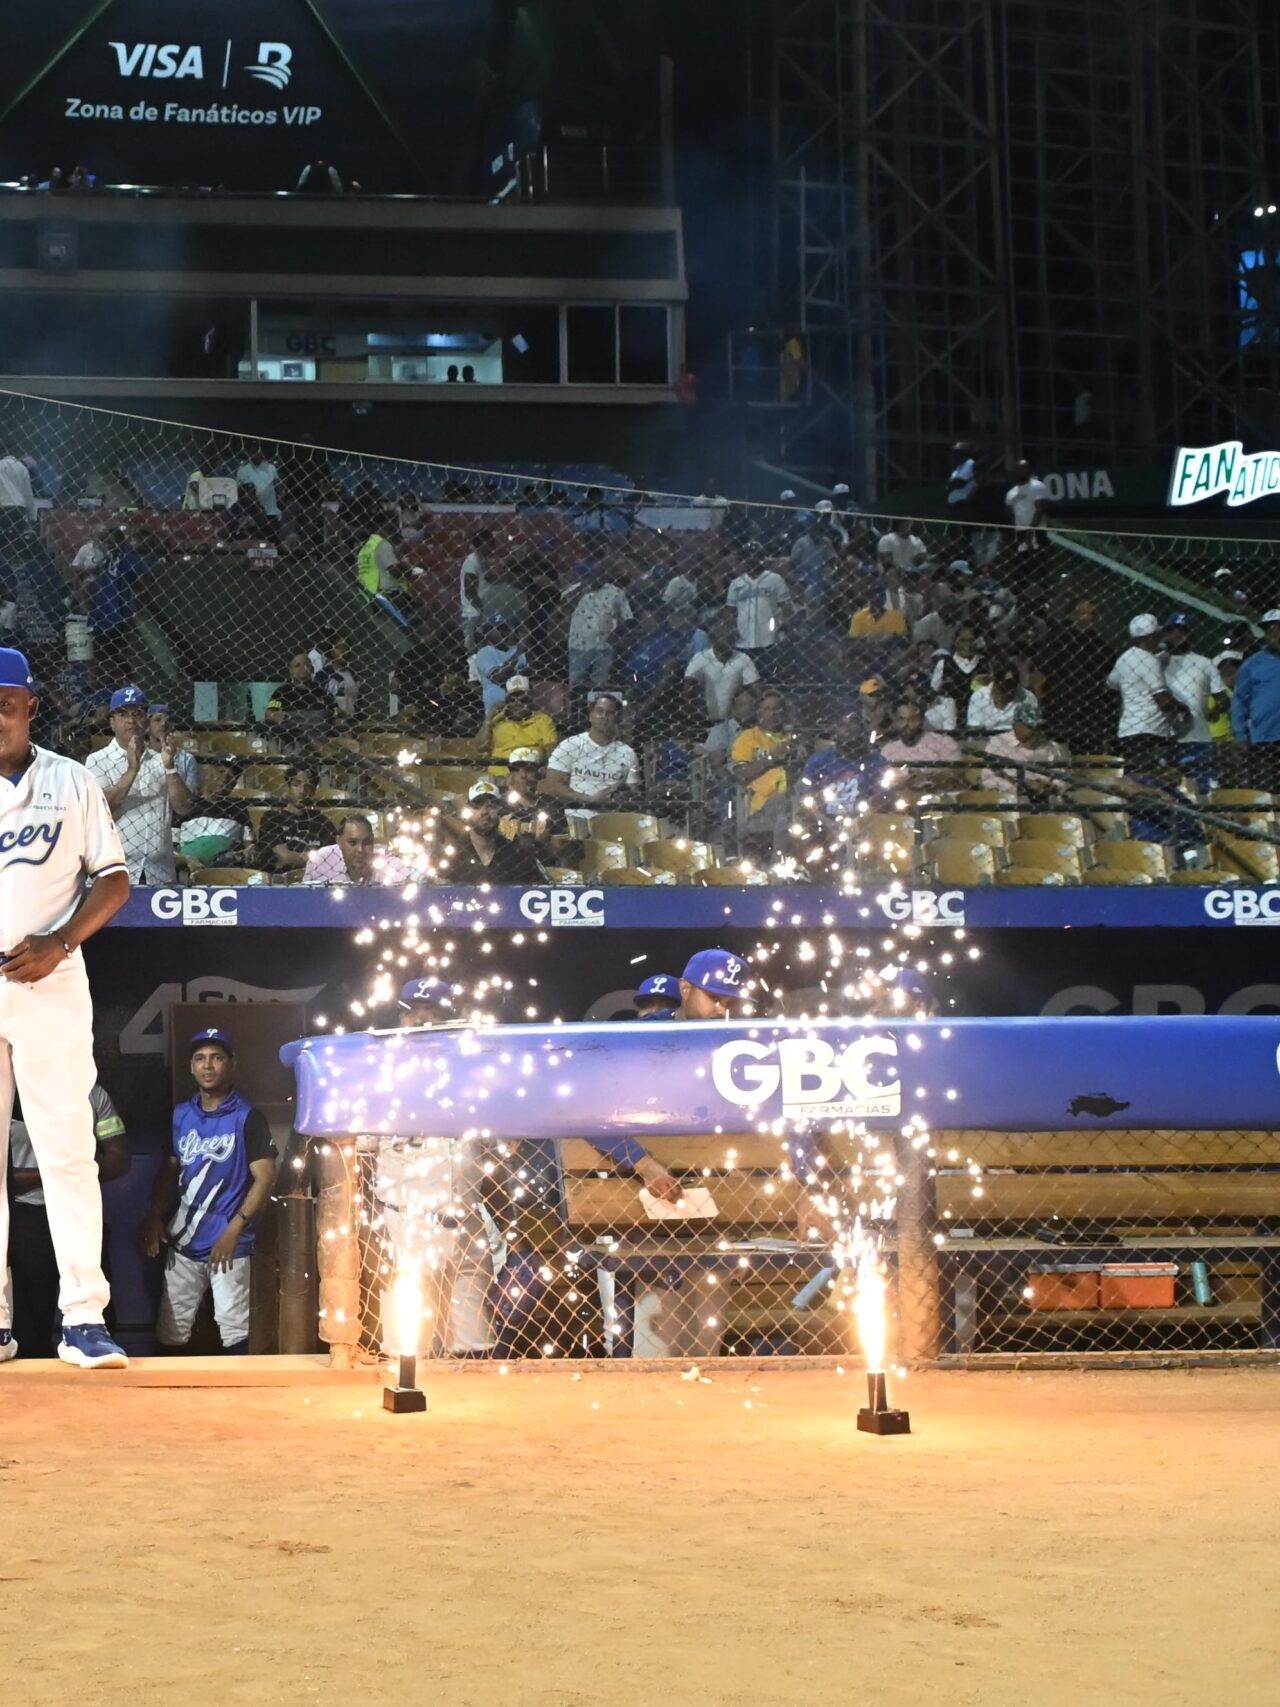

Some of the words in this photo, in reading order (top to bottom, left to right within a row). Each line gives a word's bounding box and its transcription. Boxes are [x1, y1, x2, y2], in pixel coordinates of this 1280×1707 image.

[108, 42, 203, 79] VISA
[65, 97, 123, 120] Zona
[129, 101, 158, 121] de
[164, 103, 277, 124] Fanáticos
[283, 106, 322, 125] VIP
[286, 335, 336, 353] GBC
[1044, 470, 1115, 501] ONA
[151, 888, 237, 919] GBC
[520, 890, 604, 920] GBC
[881, 890, 965, 920] GBC
[650, 977, 668, 993] L
[712, 1037, 901, 1106] GBC
[178, 1128, 236, 1165] Licey
